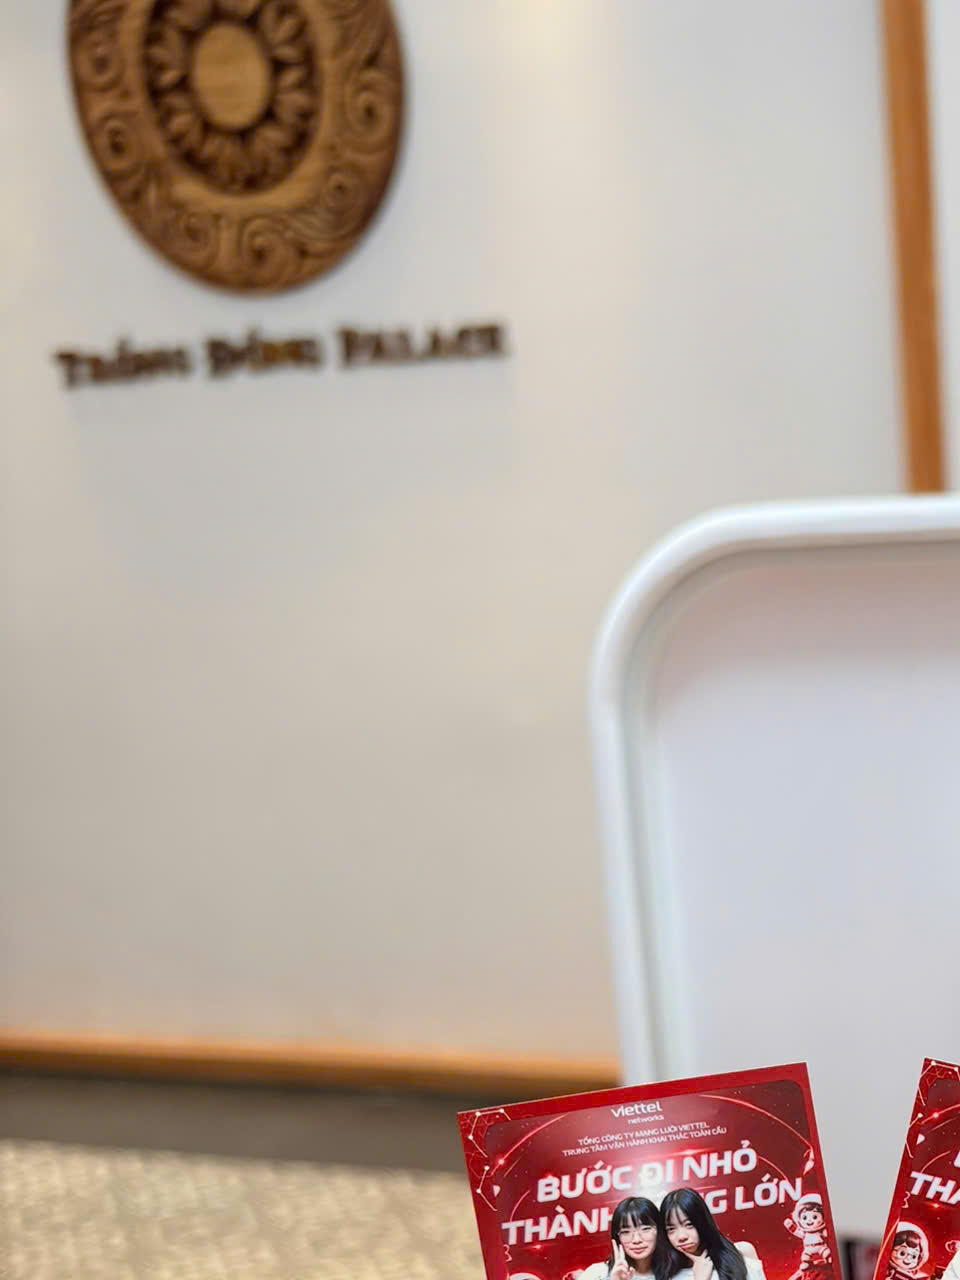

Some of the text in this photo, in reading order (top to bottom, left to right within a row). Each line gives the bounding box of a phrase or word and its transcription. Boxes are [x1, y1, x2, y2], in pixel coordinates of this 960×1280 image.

[611, 1102, 662, 1117] viettel
[601, 1133, 623, 1142] CÔNG
[623, 1131, 634, 1139] TY
[678, 1122, 709, 1132] VIETTEL
[562, 1146, 590, 1156] TRUNG
[537, 1140, 757, 1202] BƯỚC ĐI NHỎ
[735, 1174, 803, 1210] LỚN
